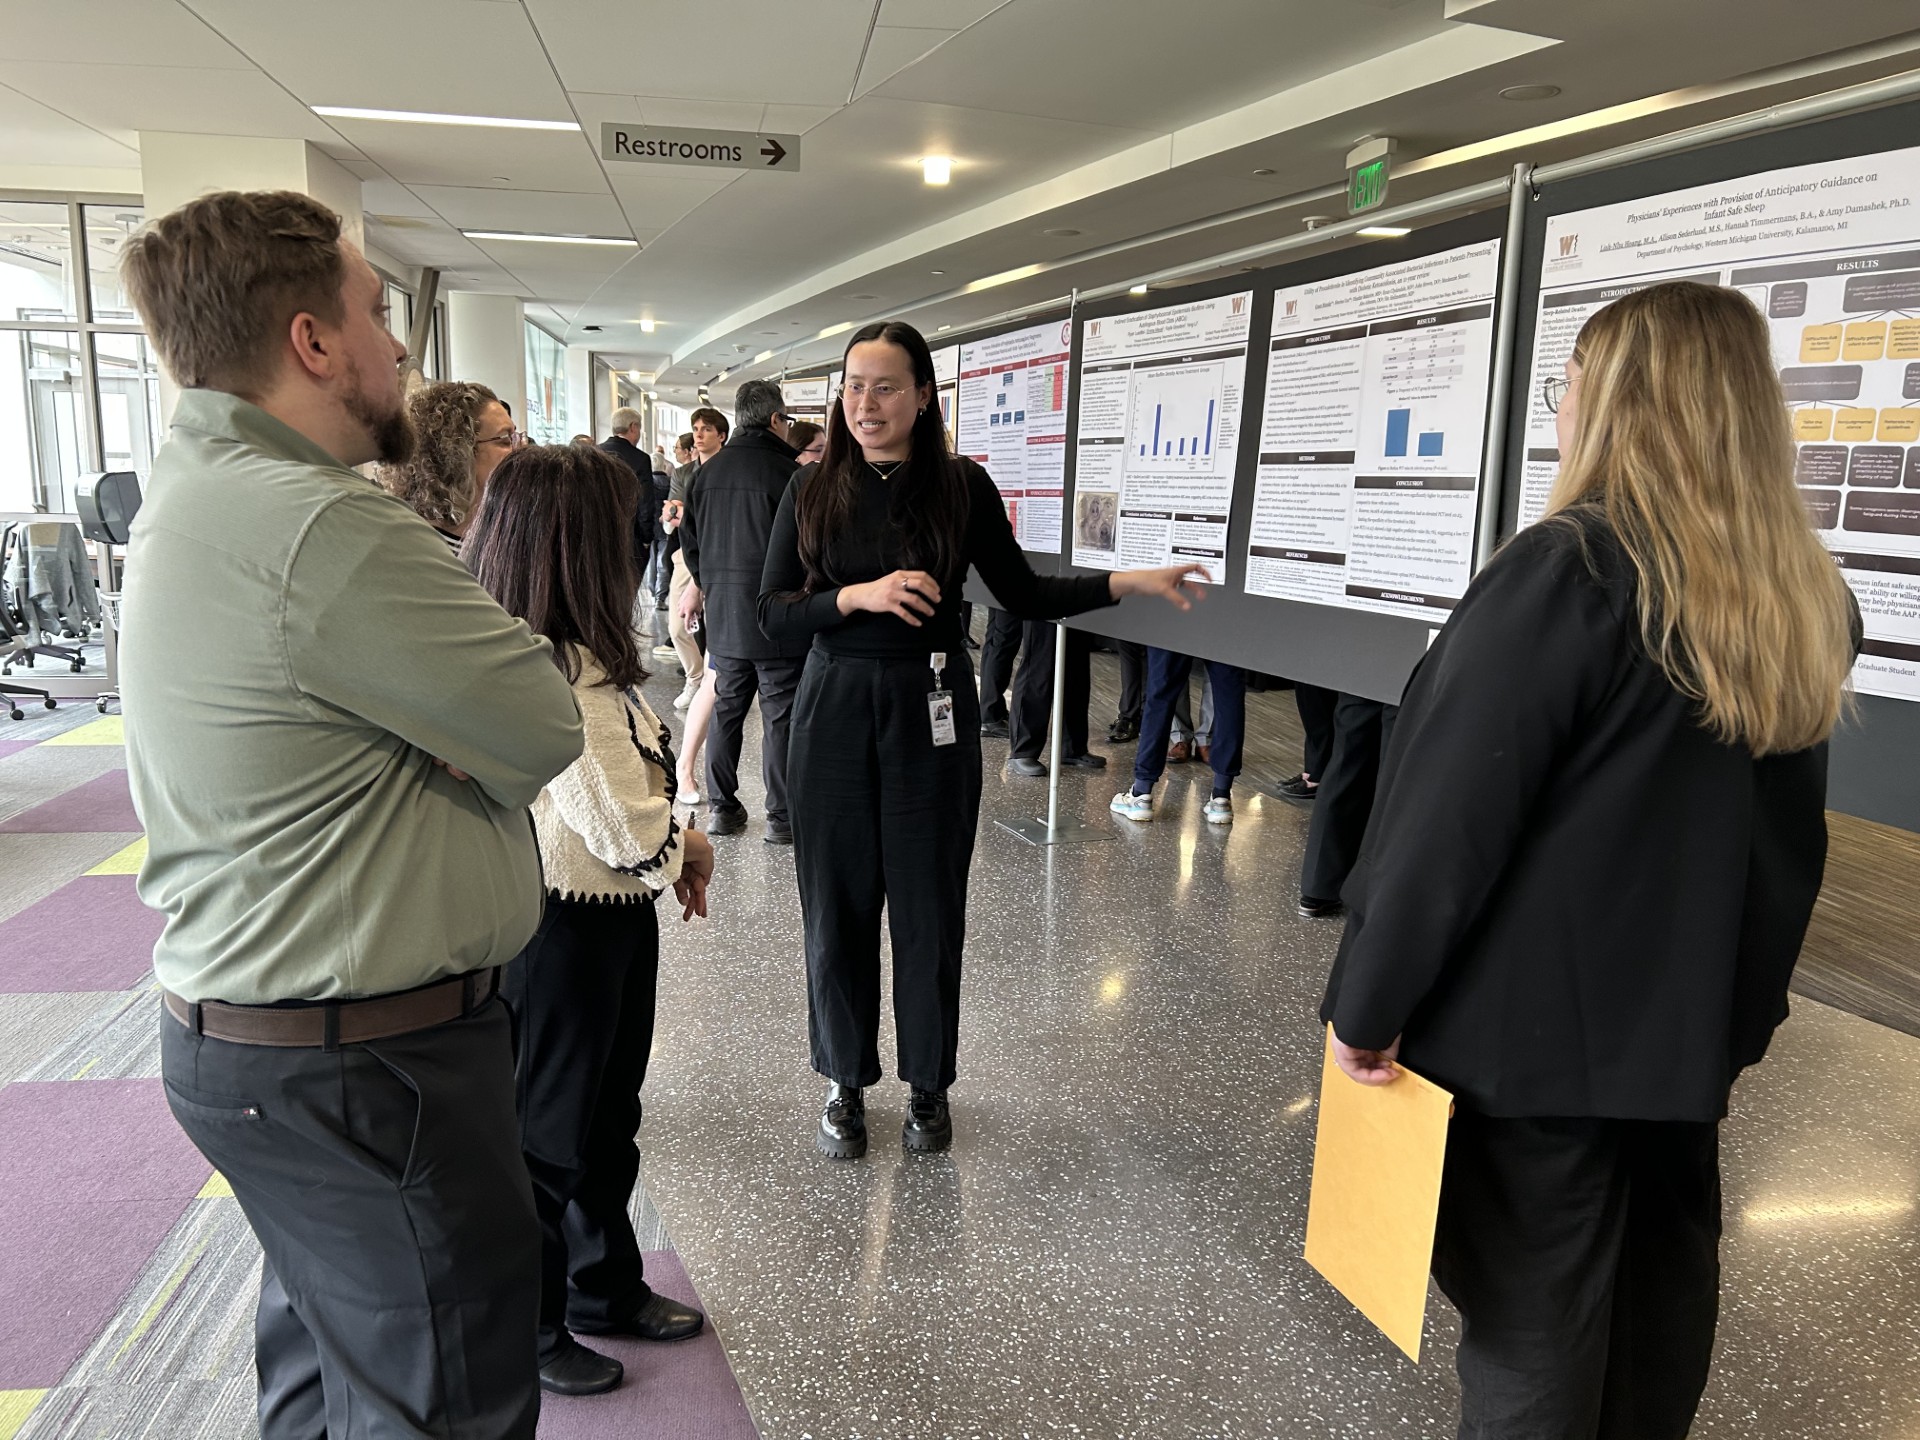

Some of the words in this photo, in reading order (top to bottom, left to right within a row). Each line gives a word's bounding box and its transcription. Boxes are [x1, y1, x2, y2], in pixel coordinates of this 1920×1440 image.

[615, 132, 742, 161] Restrooms
[1354, 161, 1384, 210] EXIT
[1627, 209, 1663, 223] Physicians'
[1662, 203, 1702, 217] Experiences
[1703, 198, 1719, 208] with
[1720, 192, 1753, 206] Provision
[1755, 188, 1764, 199] of
[1764, 182, 1818, 197] Anticipatory
[1820, 175, 1864, 189] Guidance
[1865, 173, 1878, 182] on
[1704, 209, 1726, 221] Infant
[1727, 205, 1743, 217] Safe
[1744, 203, 1766, 214] Sleep
[1725, 220, 1749, 231] Hannah
[1750, 214, 1798, 227] Timmermans,
[1800, 211, 1817, 220] B.A.,
[1818, 209, 1825, 217] &
[1826, 207, 1844, 217] Amy
[1845, 201, 1888, 214] Damashek,
[1889, 198, 1911, 208] Ph.D.
[1637, 247, 1666, 259] Department
[1667, 246, 1673, 254] of
[1673, 242, 1704, 253] Psychology,
[1705, 239, 1728, 248] Western
[1729, 234, 1757, 245] Michigan
[1759, 229, 1794, 240] University,
[1796, 223, 1835, 235] Kalamazoo,
[1837, 221, 1848, 230] MI
[1836, 259, 1879, 271] RESULTS
[1848, 577, 1871, 587] discuss
[1871, 579, 1890, 588] infant
[1891, 581, 1905, 590] safe
[1869, 588, 1889, 598] ability
[1858, 597, 1871, 605] may
[1872, 598, 1886, 607] help
[1882, 607, 1890, 615] of
[1890, 608, 1901, 616] the
[1901, 609, 1917, 618] AAP
[1858, 662, 1888, 673] Graduate
[1888, 665, 1916, 677] Student
